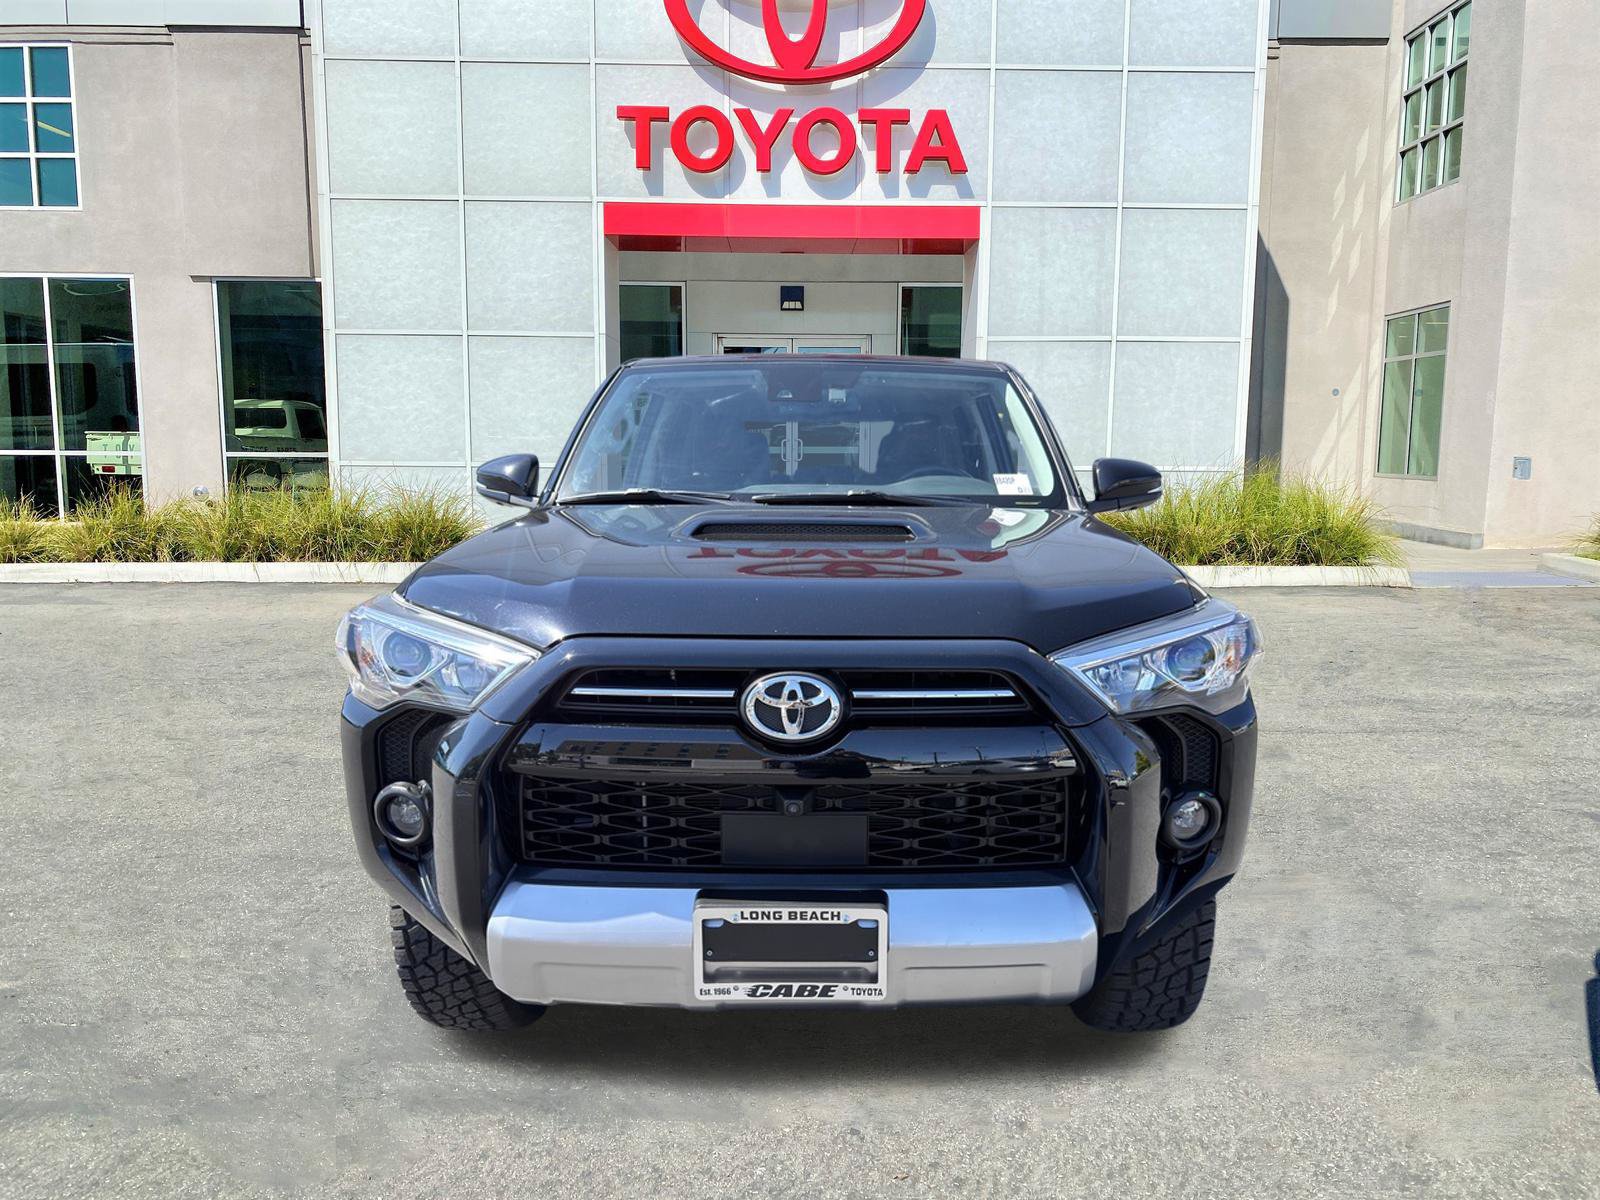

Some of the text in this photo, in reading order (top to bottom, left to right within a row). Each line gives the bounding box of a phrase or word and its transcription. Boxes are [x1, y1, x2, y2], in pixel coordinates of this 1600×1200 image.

[616, 105, 968, 175] TOYOTA
[740, 910, 842, 921] LONG BEACH
[699, 987, 731, 996] Est. 1966
[747, 985, 839, 998] CABE
[851, 987, 883, 996] TOYOTA
